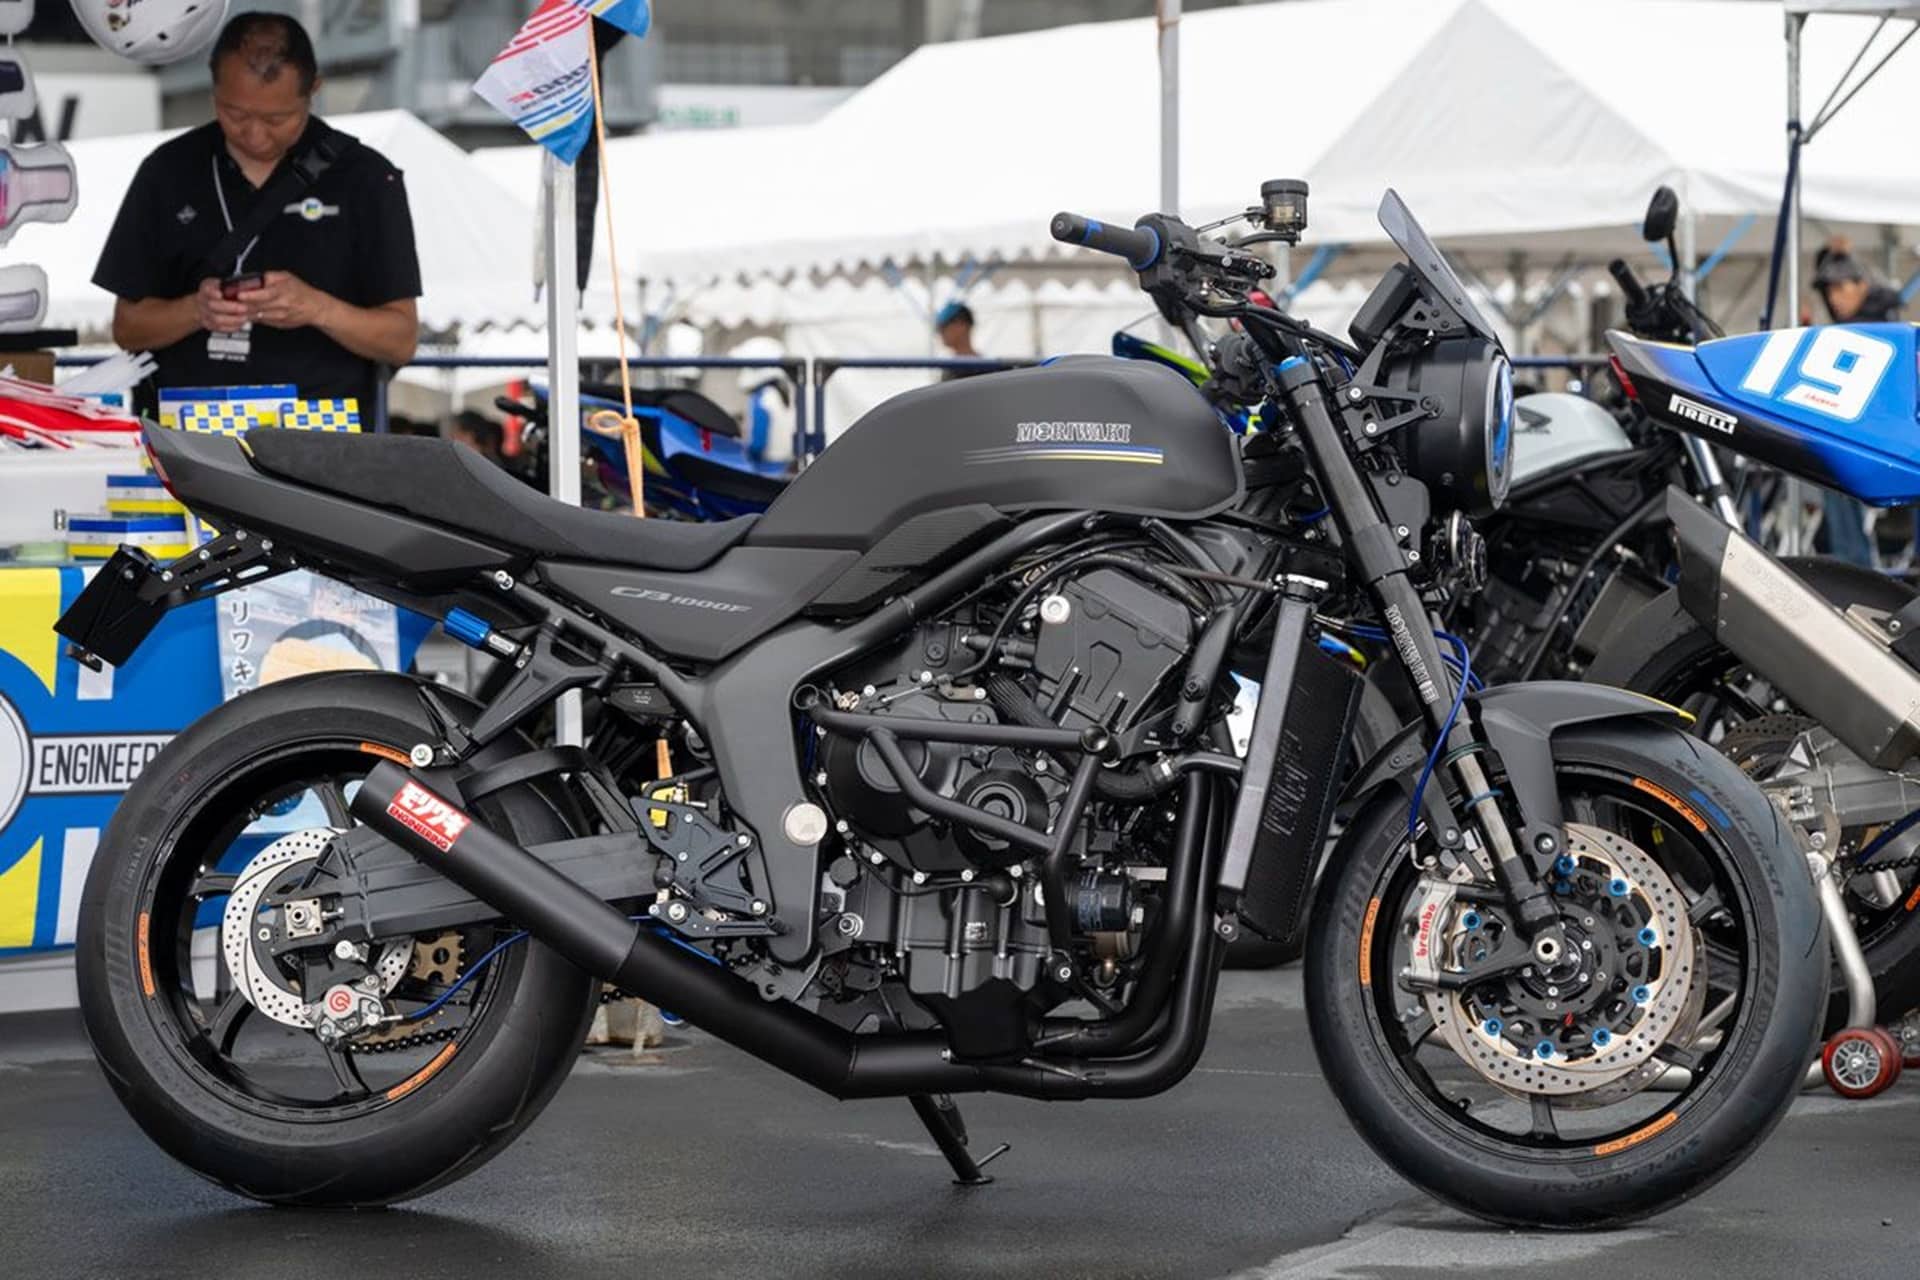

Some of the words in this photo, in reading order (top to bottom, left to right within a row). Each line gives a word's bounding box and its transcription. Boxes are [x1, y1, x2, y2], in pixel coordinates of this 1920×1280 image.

[1742, 327, 1894, 420] 19
[1016, 422, 1131, 443] MORIWAKI
[1668, 394, 1739, 434] PIRELLI
[232, 586, 253, 696] リワキ
[39, 743, 168, 785] ENGINEE
[399, 781, 468, 838] モリワキ
[1415, 903, 1436, 957] brembo
